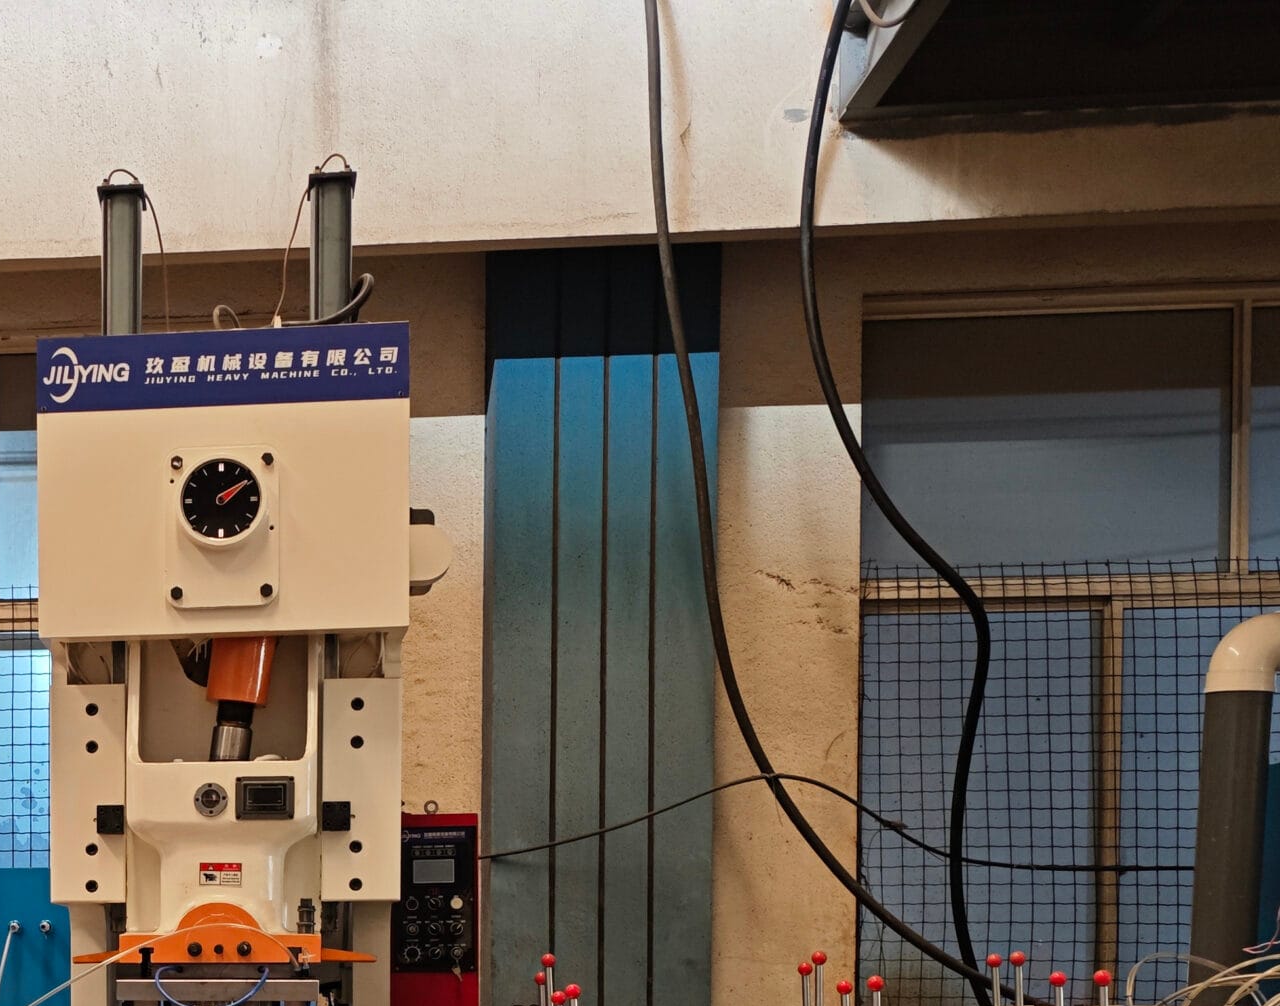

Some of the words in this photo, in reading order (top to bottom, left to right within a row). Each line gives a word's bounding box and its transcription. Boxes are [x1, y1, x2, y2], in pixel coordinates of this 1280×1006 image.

[145, 347, 399, 374] 玖盈机械设备有限公司
[144, 375, 196, 385] JIUYING
[207, 373, 249, 382] HEAVY
[261, 370, 320, 380] MACHINE
